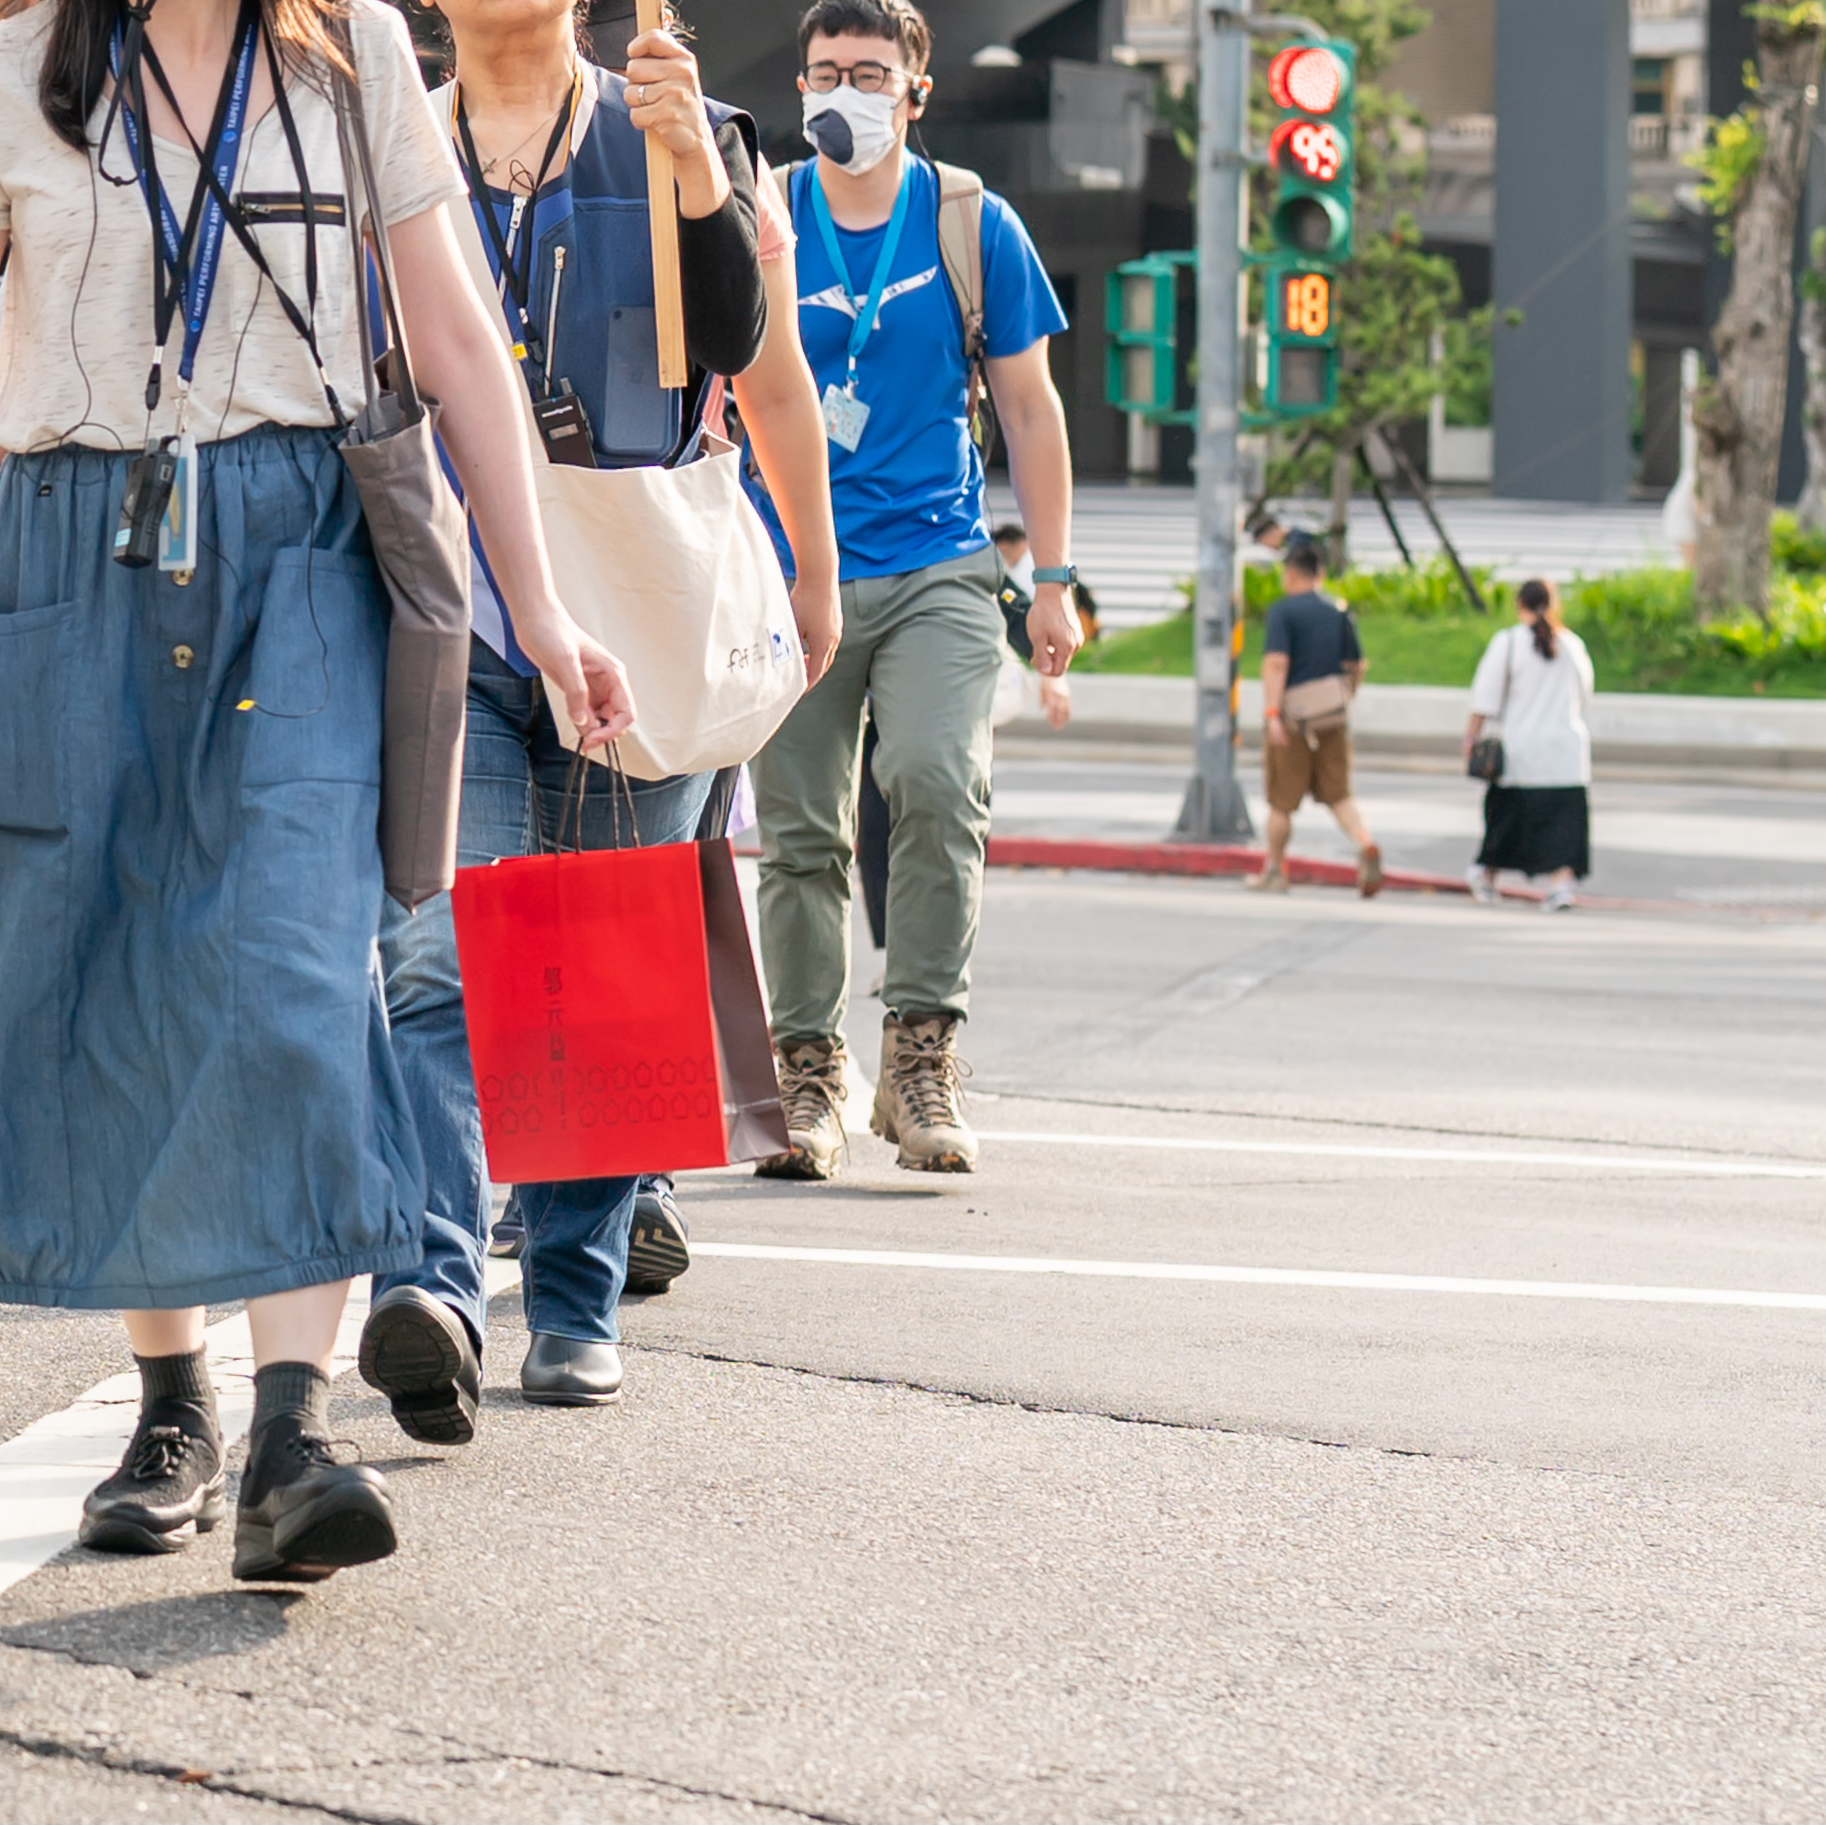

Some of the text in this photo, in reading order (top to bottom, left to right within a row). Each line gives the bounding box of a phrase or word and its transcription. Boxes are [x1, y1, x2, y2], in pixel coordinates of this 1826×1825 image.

[1290, 123, 1341, 182] 95
[197, 224, 219, 287] PERFORMING
[192, 288, 206, 317] TAIPEI
[1286, 273, 1329, 336] 18
